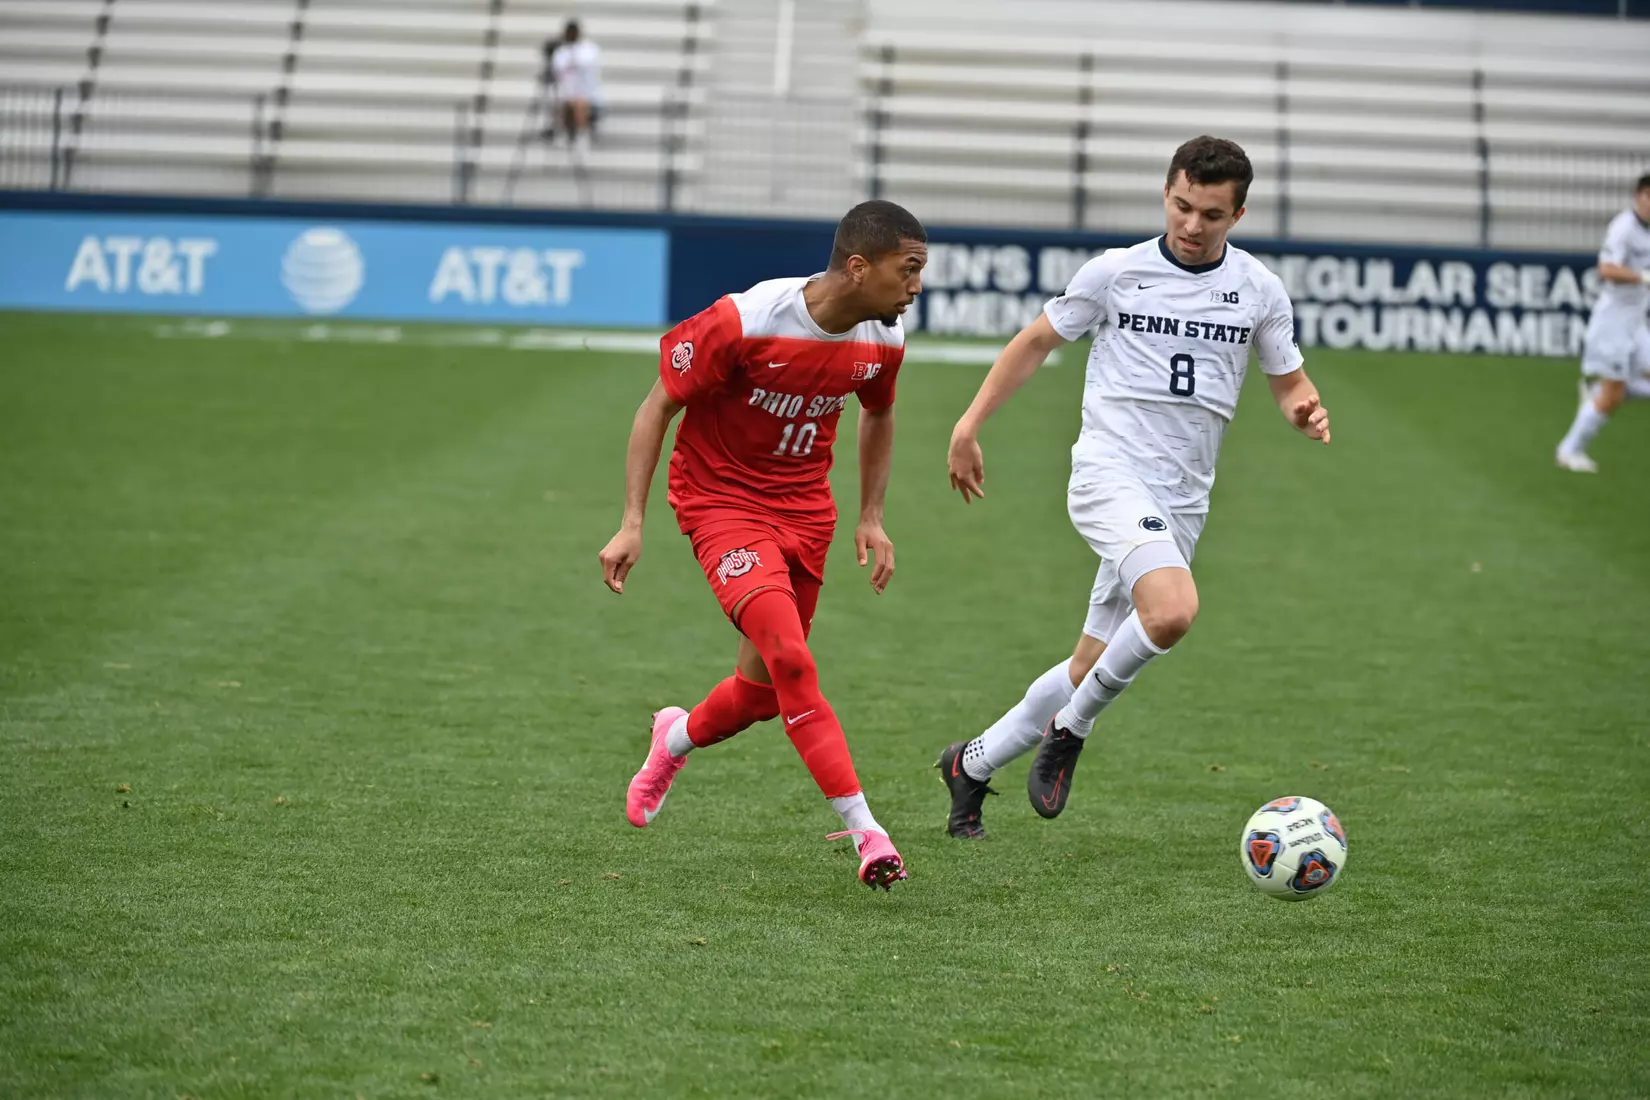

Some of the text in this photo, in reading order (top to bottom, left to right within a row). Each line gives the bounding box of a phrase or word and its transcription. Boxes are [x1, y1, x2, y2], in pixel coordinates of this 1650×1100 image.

[66, 235, 217, 294] AT&T
[429, 246, 585, 305] AT&T
[921, 243, 1032, 293] EN'S
[1485, 261, 1603, 310] SEAS
[1118, 312, 1251, 344] PENN STATE
[1296, 302, 1589, 356] TOURNAMEN
[1169, 353, 1195, 397] 8
[748, 388, 804, 418] OHIO
[772, 422, 817, 457] 10
